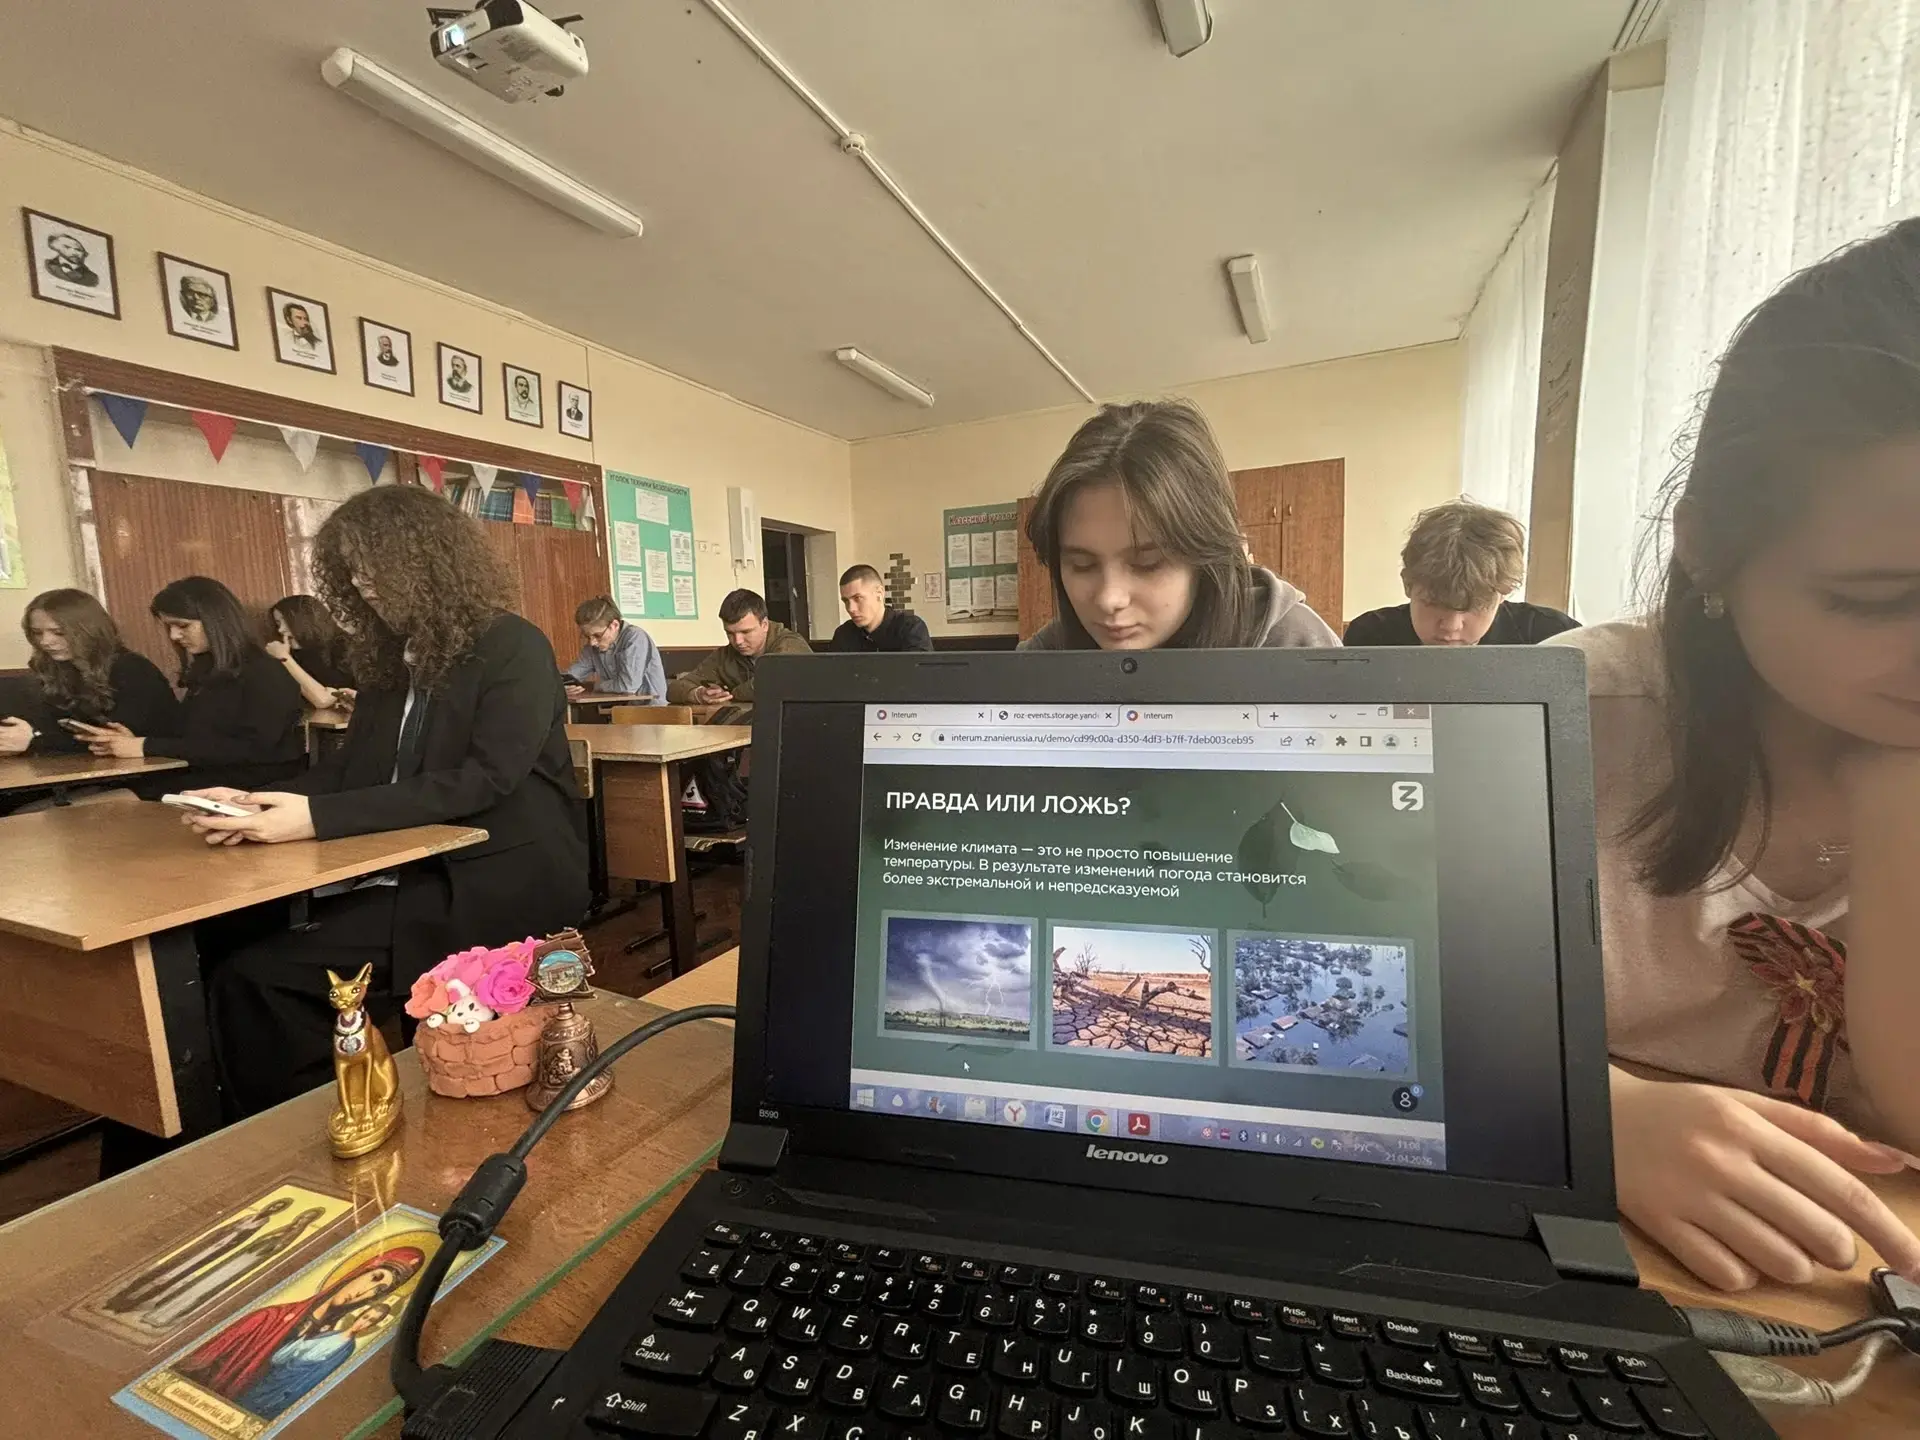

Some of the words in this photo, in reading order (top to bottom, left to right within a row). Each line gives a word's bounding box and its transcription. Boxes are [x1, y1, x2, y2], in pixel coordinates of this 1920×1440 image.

[891, 711, 918, 719] Interum
[1143, 712, 1173, 720] Interum
[886, 791, 979, 814] ПРАВДА
[986, 794, 1035, 813] ИЛИ
[1041, 796, 1131, 816] ЛОЖЬ?
[884, 838, 958, 852] Изменение
[961, 842, 1017, 855] климата
[1038, 845, 1062, 856] это
[1066, 847, 1082, 858] не
[1087, 847, 1138, 862] просто
[1144, 850, 1233, 864] повышение
[883, 856, 975, 872] температуры.
[980, 859, 988, 870] В
[992, 860, 1070, 876] результате
[1074, 863, 1154, 878] изменений
[1160, 868, 1212, 883] погода
[1216, 871, 1306, 885] становится
[882, 872, 923, 885] более
[926, 874, 1031, 891] экстремальной
[1036, 880, 1044, 890] и
[1048, 881, 1180, 898] непредсказуемой
[759, 1109, 778, 1119] B590
[1086, 1144, 1169, 1165] lenovo
[714, 1224, 730, 1233] Esc
[760, 1232, 772, 1240] F1
[920, 1256, 932, 1264] F5
[961, 1261, 973, 1269] F6
[734, 1269, 744, 1278] 1
[1004, 1266, 1017, 1274] F7
[780, 1277, 794, 1287] 2
[1048, 1273, 1061, 1281] F8
[828, 1284, 840, 1294] 3
[1094, 1279, 1107, 1288] F9
[878, 1291, 889, 1301] 4
[1140, 1286, 1156, 1295] F10
[668, 1298, 685, 1308] Tab
[1187, 1293, 1202, 1302] F11
[743, 1299, 759, 1312] Q
[928, 1299, 940, 1309] 5
[1234, 1300, 1251, 1308] F12
[792, 1306, 812, 1320] W
[980, 1306, 991, 1317] 6
[1283, 1307, 1306, 1317] PrtSc
[756, 1317, 767, 1328] Й
[842, 1314, 858, 1328] E
[1034, 1314, 1044, 1325] 7
[1333, 1314, 1358, 1324] Insert
[805, 1324, 816, 1337] Ц
[894, 1323, 909, 1336] R
[1088, 1324, 1098, 1334] 8
[1387, 1322, 1418, 1334] Delete
[948, 1331, 960, 1344] T
[1144, 1332, 1153, 1343] 9
[1449, 1332, 1478, 1342] Home
[1003, 1339, 1015, 1353] Y
[1201, 1341, 1210, 1353] 0
[1503, 1339, 1523, 1349] End
[635, 1347, 671, 1362] CapsLk
[731, 1347, 747, 1361] A
[1058, 1349, 1072, 1363] U
[1560, 1348, 1588, 1360] PgUp
[782, 1356, 798, 1370] S
[1617, 1356, 1647, 1368] PgDn
[743, 1369, 754, 1379] Ф
[837, 1365, 853, 1379] D
[1081, 1372, 1090, 1383] Г
[1174, 1369, 1189, 1383] O
[1386, 1369, 1443, 1387] Backspace
[1473, 1372, 1497, 1384] Num
[795, 1378, 808, 1390] Ы
[892, 1375, 908, 1389] F
[1138, 1382, 1151, 1394] Ш
[1235, 1378, 1248, 1392] P
[949, 1384, 964, 1400] G
[1477, 1383, 1502, 1394] Lock
[1008, 1395, 1024, 1410] H
[1198, 1389, 1212, 1404] Щ
[621, 1399, 648, 1413] Shift
[728, 1405, 749, 1421] Z
[970, 1409, 980, 1421] П
[1068, 1407, 1080, 1421] J
[786, 1414, 805, 1432] X
[1130, 1417, 1145, 1434] K
[1504, 1423, 1515, 1435] 7
